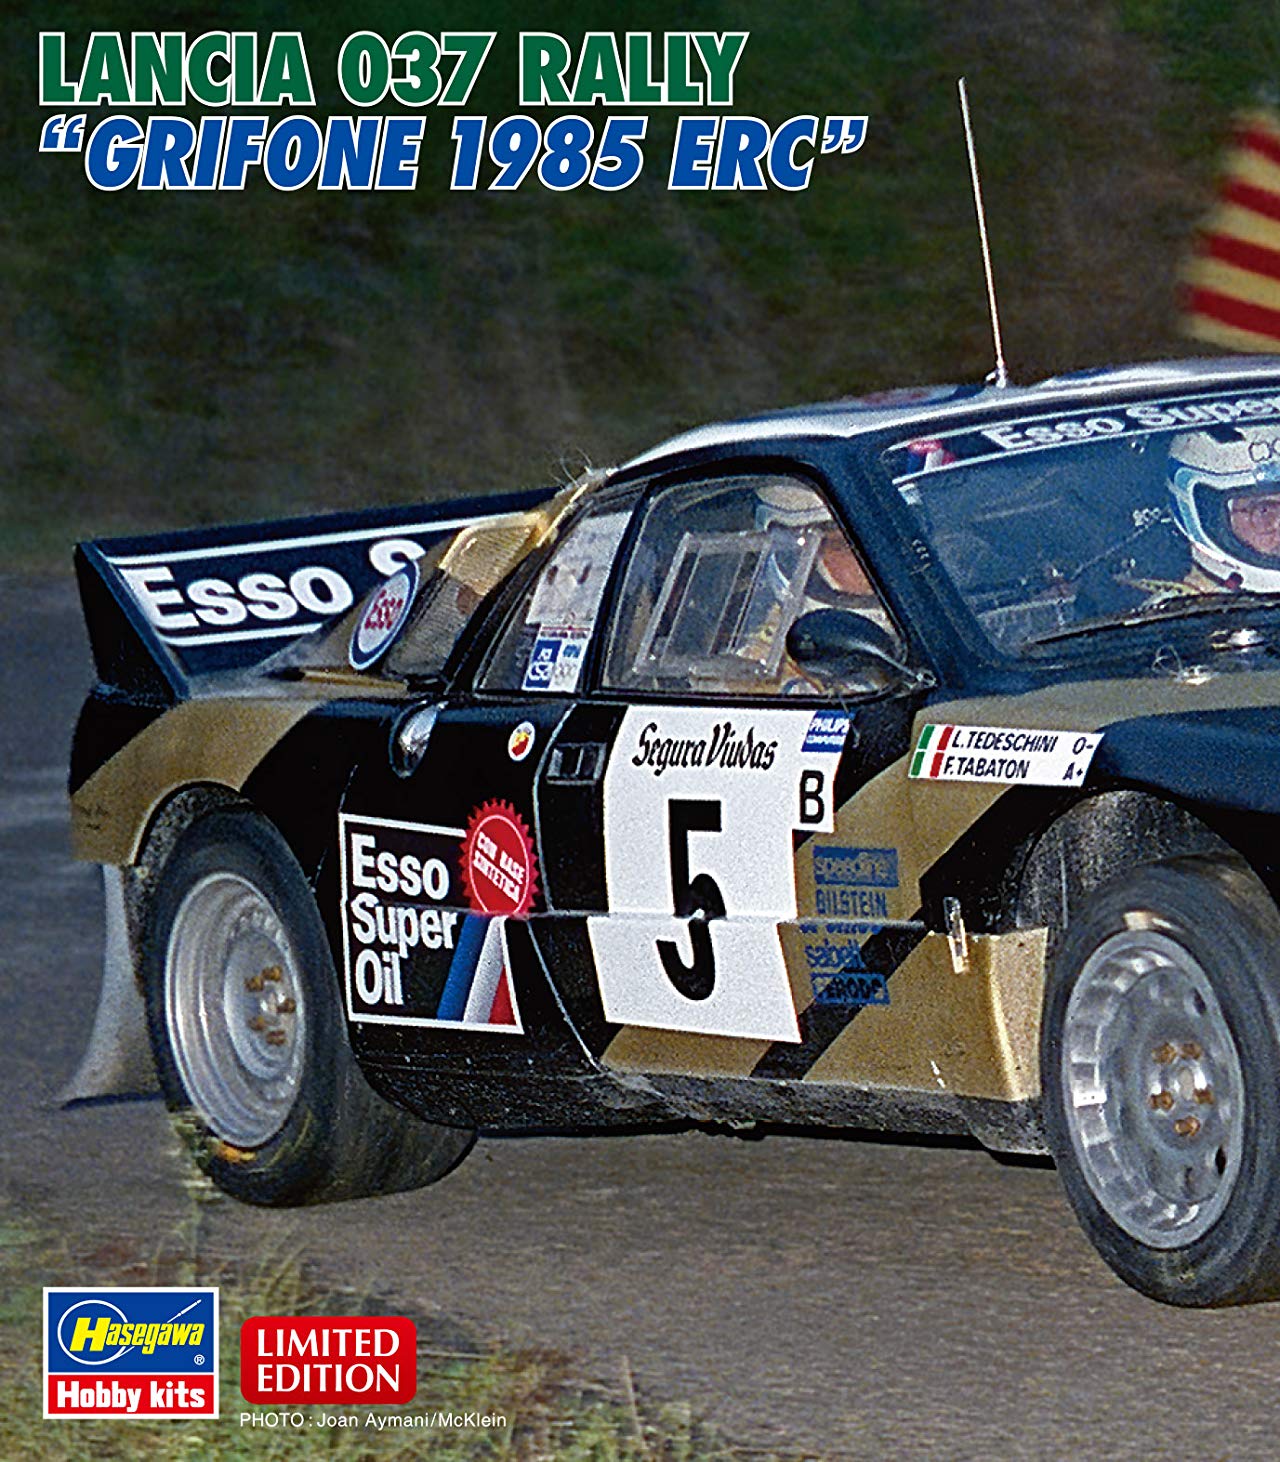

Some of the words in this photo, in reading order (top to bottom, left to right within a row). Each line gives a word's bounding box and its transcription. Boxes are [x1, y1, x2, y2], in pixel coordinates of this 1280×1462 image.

[981, 416, 1126, 450] Esso
[119, 565, 353, 631] Esso
[631, 722, 707, 777] Segura
[705, 721, 778, 770] Viudas
[800, 770, 824, 824] B
[351, 833, 450, 900] Esso
[351, 892, 458, 959] Super
[656, 799, 727, 1001] 5
[355, 948, 404, 1006] Oil
